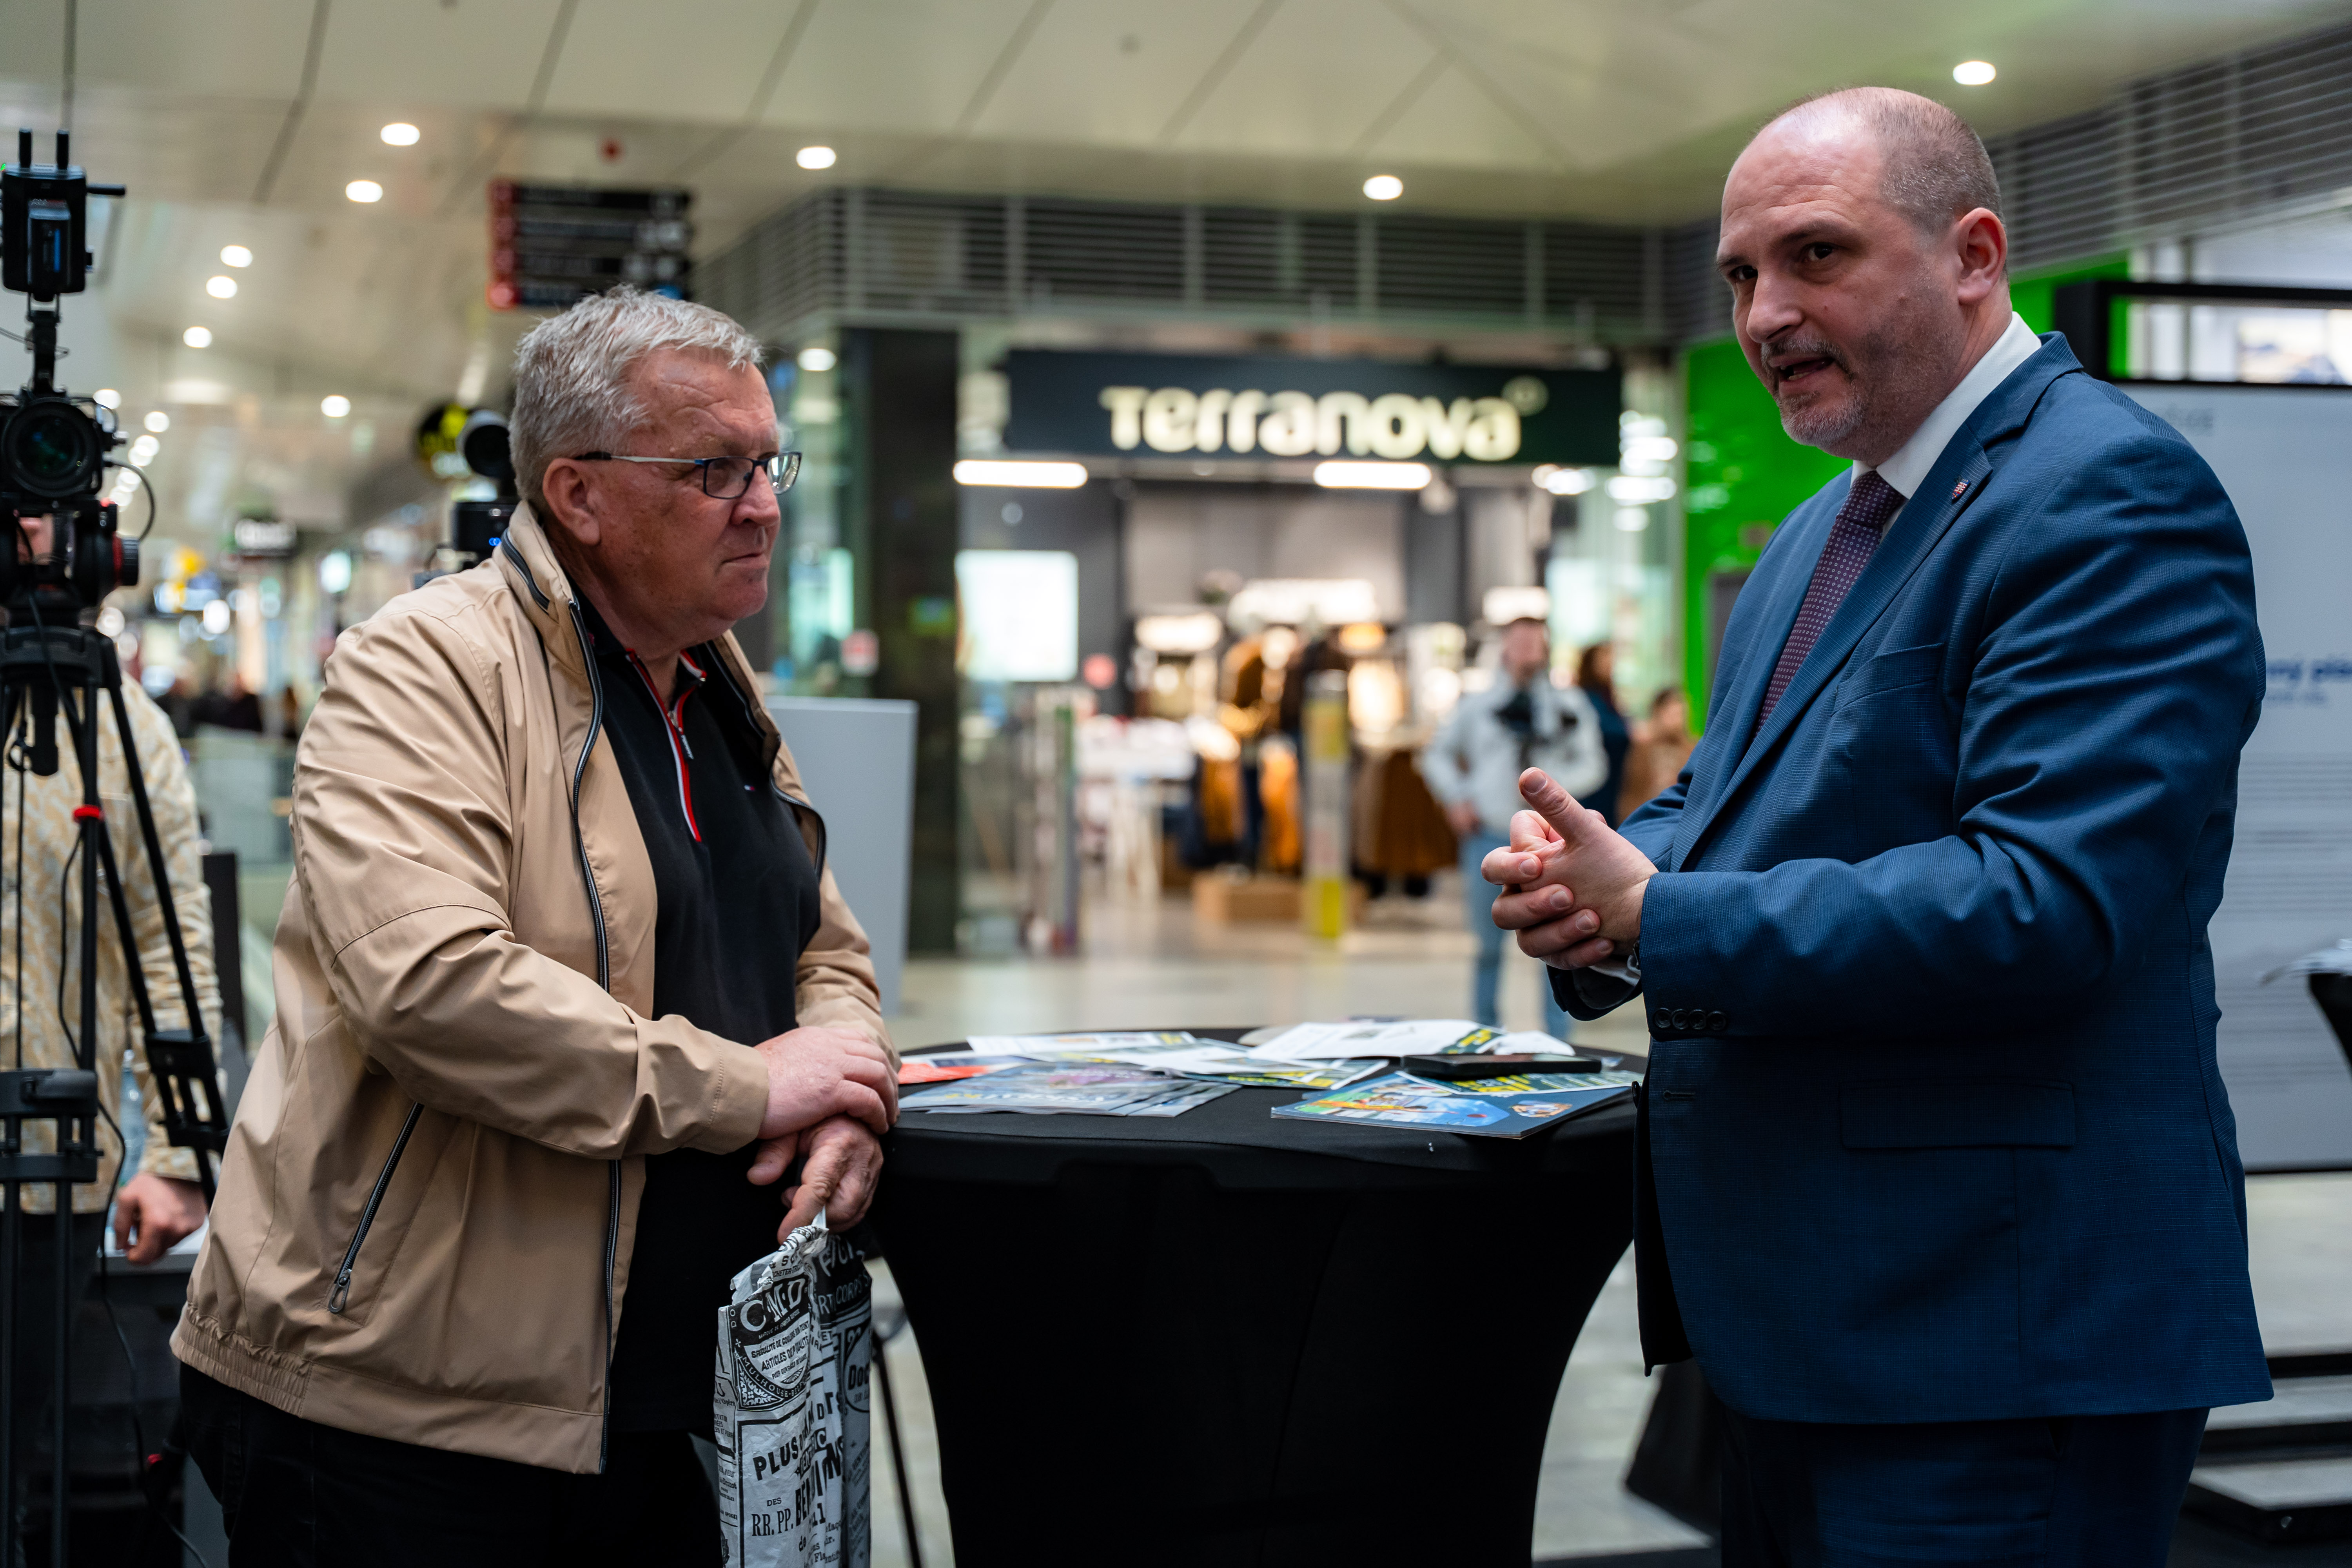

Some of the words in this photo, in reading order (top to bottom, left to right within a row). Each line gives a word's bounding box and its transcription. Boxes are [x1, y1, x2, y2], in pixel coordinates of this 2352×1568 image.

[776, 1339, 782, 1348] DE
[762, 1351, 787, 1372] ARTICLES
[753, 1436, 799, 1481] PLUS
[767, 1497, 782, 1507] DES
[751, 1513, 775, 1536] RR.
[777, 1508, 793, 1534] PP.
